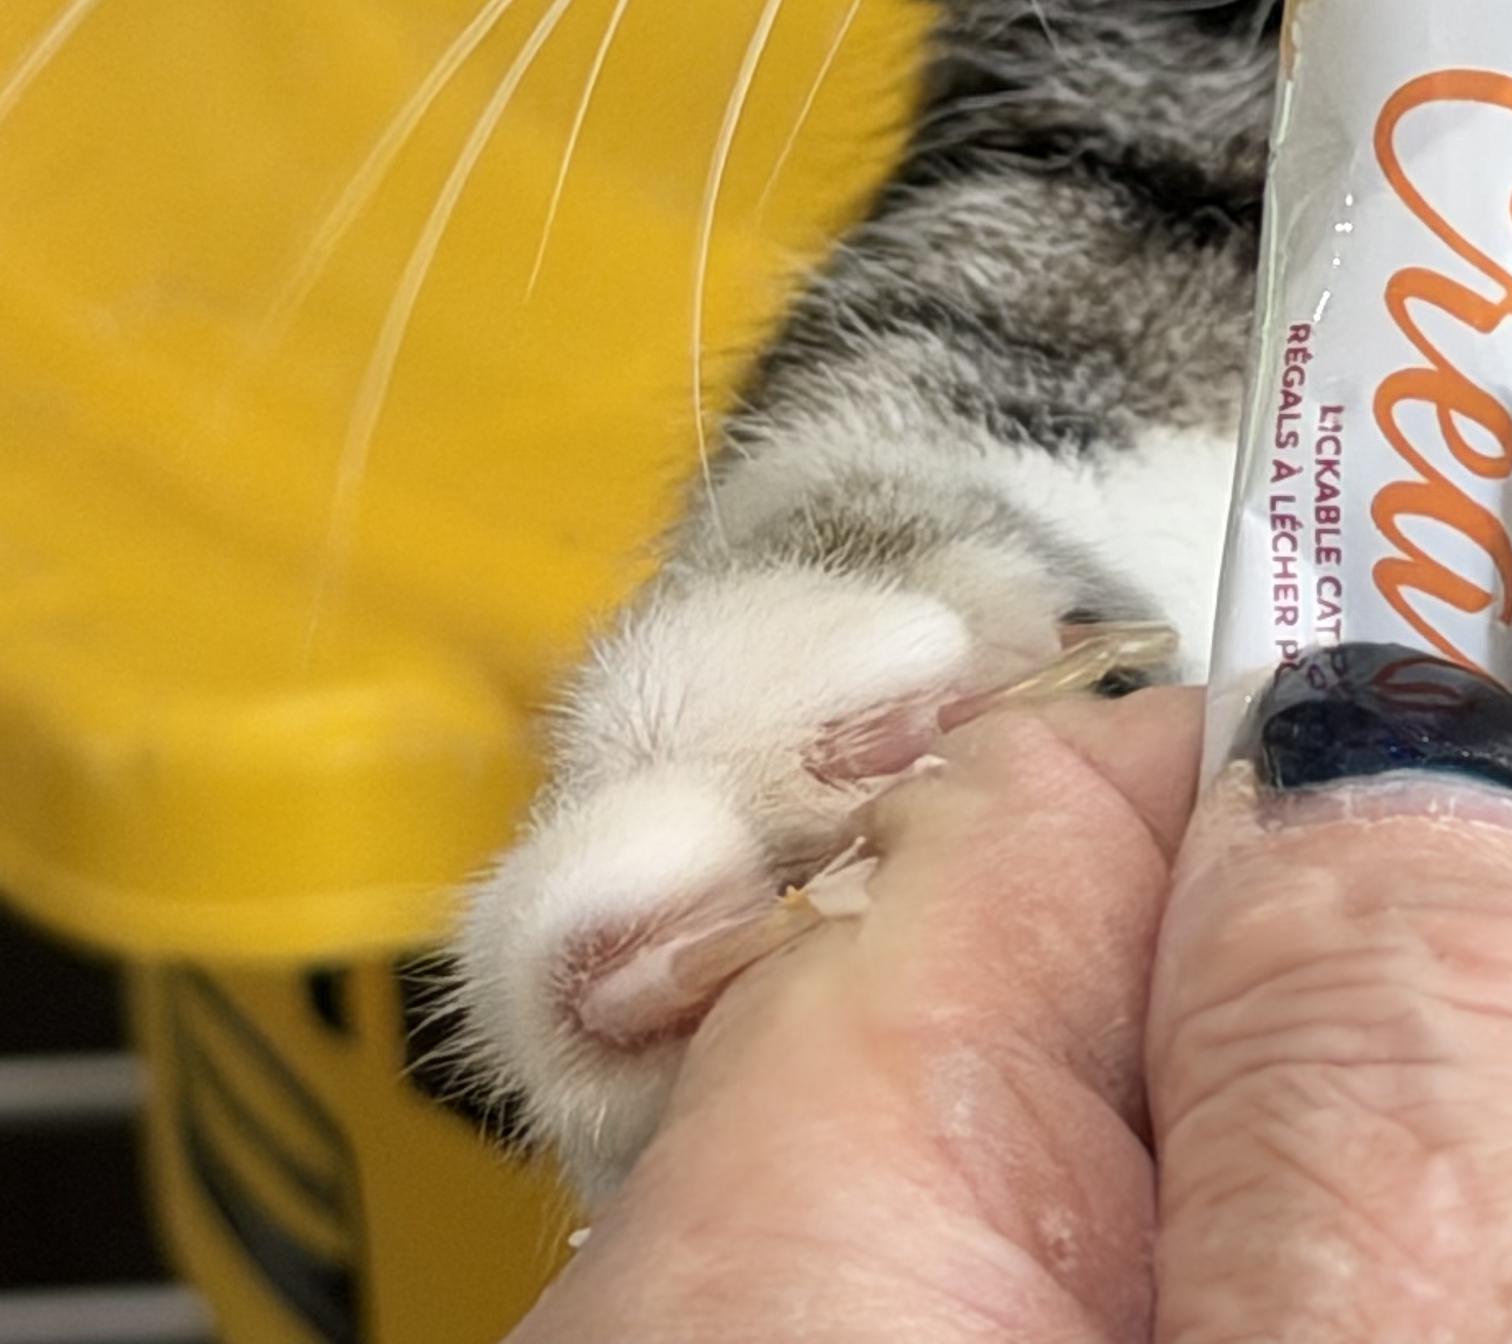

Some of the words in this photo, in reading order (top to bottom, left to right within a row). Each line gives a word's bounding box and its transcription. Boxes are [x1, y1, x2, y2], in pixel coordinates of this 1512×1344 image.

[1274, 322, 1314, 449] RÉGALS
[1270, 459, 1303, 484] À
[1315, 405, 1344, 565] LICKABLE
[1270, 495, 1303, 627] LÉCHER
[1315, 575, 1342, 642] CAT
